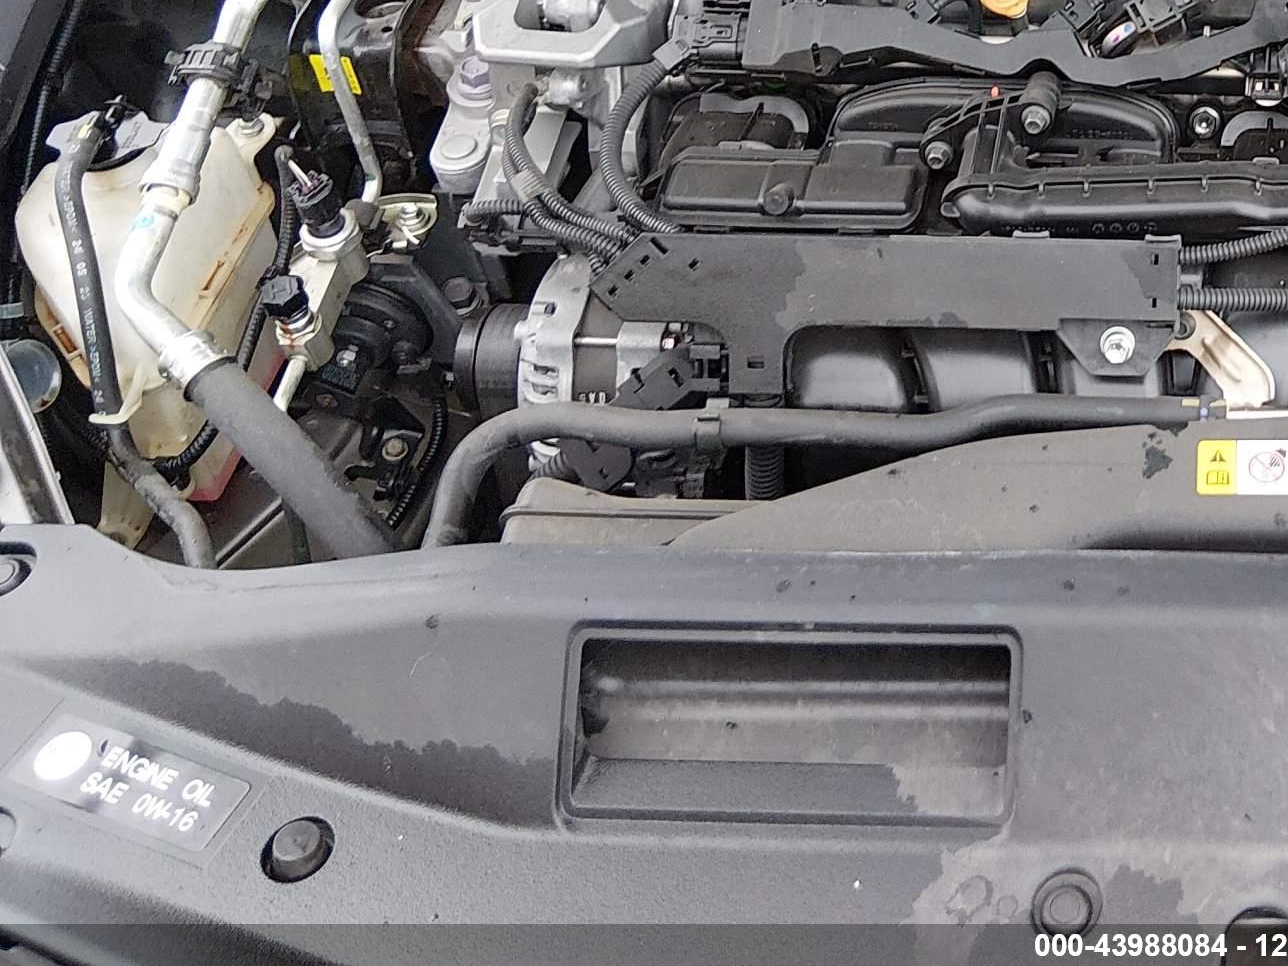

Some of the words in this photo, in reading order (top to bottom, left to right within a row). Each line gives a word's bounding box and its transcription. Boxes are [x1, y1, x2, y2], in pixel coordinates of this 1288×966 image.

[79, 771, 130, 804] SAE
[131, 793, 199, 832] 0W-16
[101, 745, 180, 791] ENGINE
[181, 778, 216, 808] OIL
